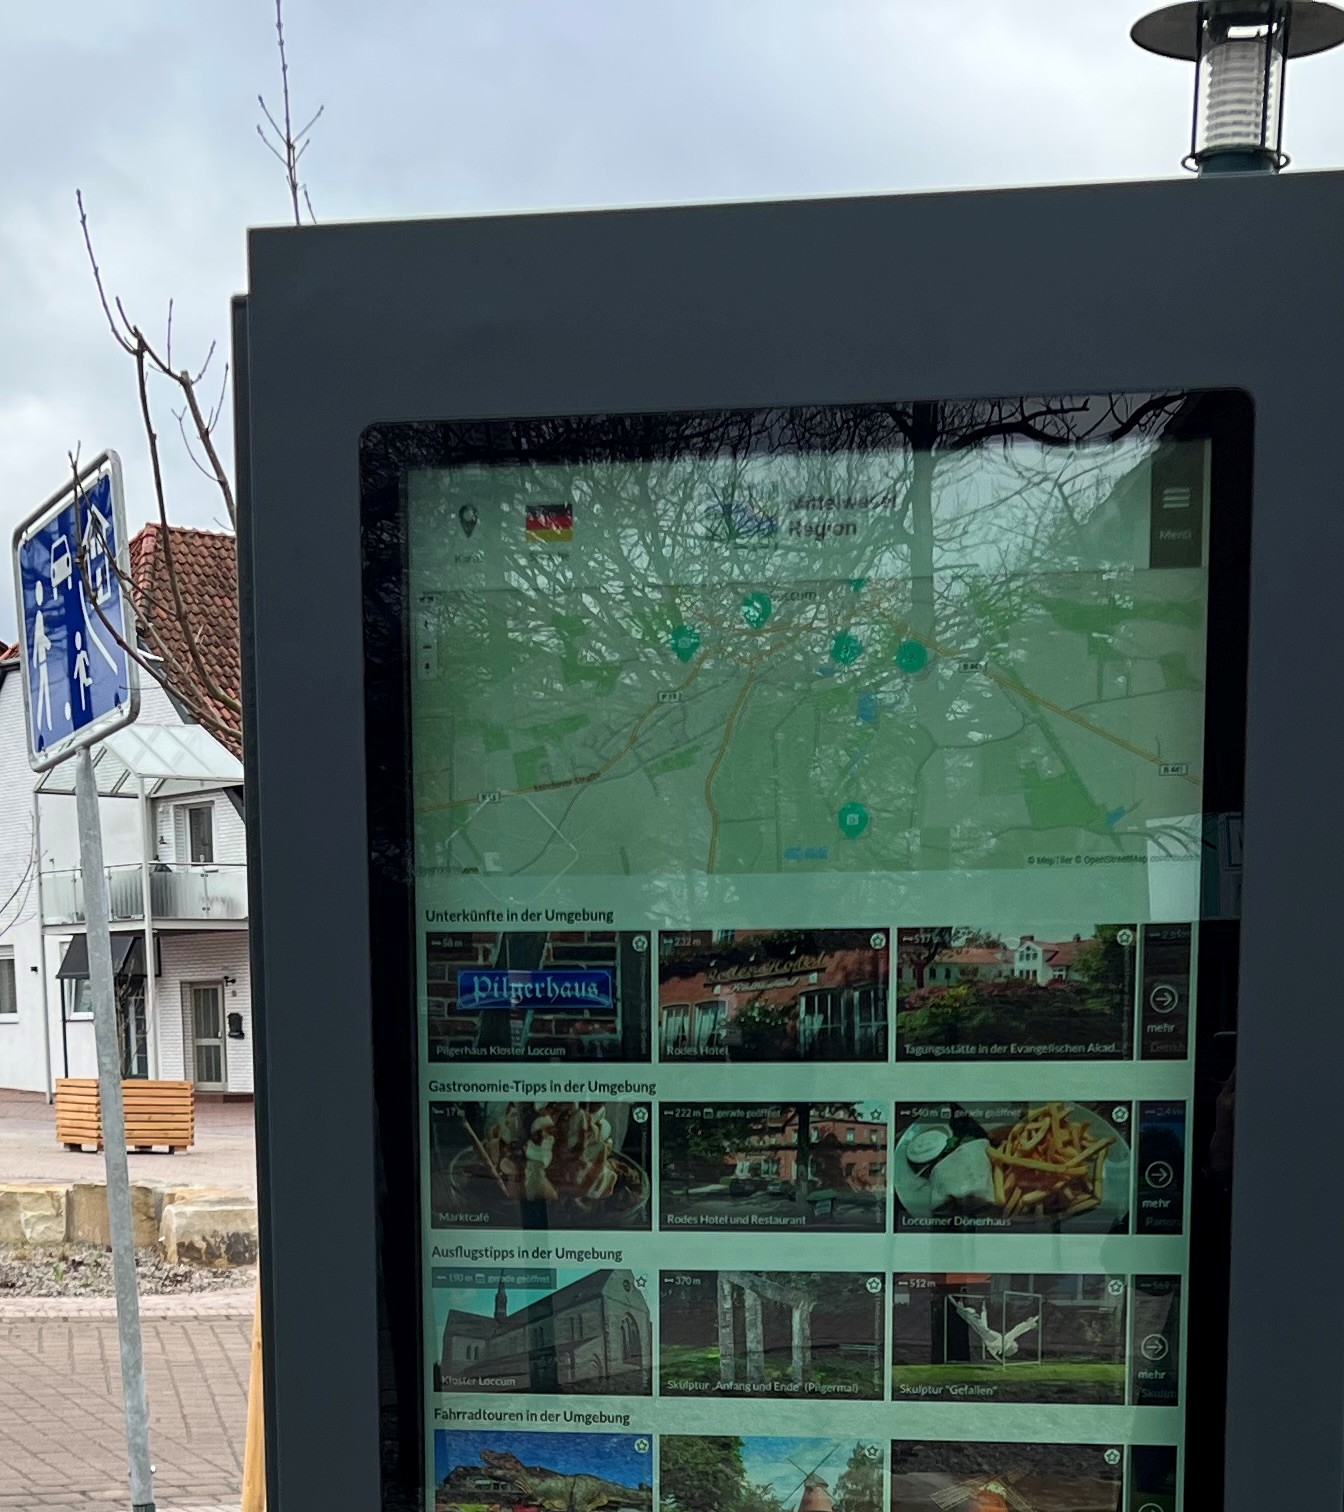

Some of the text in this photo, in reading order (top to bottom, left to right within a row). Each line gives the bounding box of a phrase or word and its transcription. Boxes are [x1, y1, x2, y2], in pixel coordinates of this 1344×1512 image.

[788, 519, 857, 541] Region
[425, 909, 614, 924] Unterkünfte in der Umgebung
[472, 974, 599, 1005] Pilgerhaus
[1146, 1021, 1176, 1034] mehr
[436, 1045, 566, 1057] Pilgerhaus Kloster Loccum
[666, 1045, 698, 1056] Rodes
[989, 1043, 1008, 1054] der
[1010, 1043, 1086, 1056] Evangelischen
[428, 1080, 656, 1096] Gastronomie-Tipps in der Umgebung
[1141, 1199, 1171, 1209] mehr
[438, 1211, 490, 1223] Marktcafé
[666, 1214, 807, 1226] Rodes Hotel und Restaurant
[901, 1215, 1011, 1227] Loccumer Dönerhaus
[432, 1246, 623, 1262] Ausflugstipps in der Umgebung
[1137, 1369, 1167, 1379] mehr
[441, 1376, 516, 1387] Kloster Loccum
[667, 1380, 710, 1391] Skulptur
[752, 1381, 771, 1391] und
[899, 1384, 944, 1395] Skulptur
[434, 1408, 631, 1426] Fahrradtouren in der Umgebung
